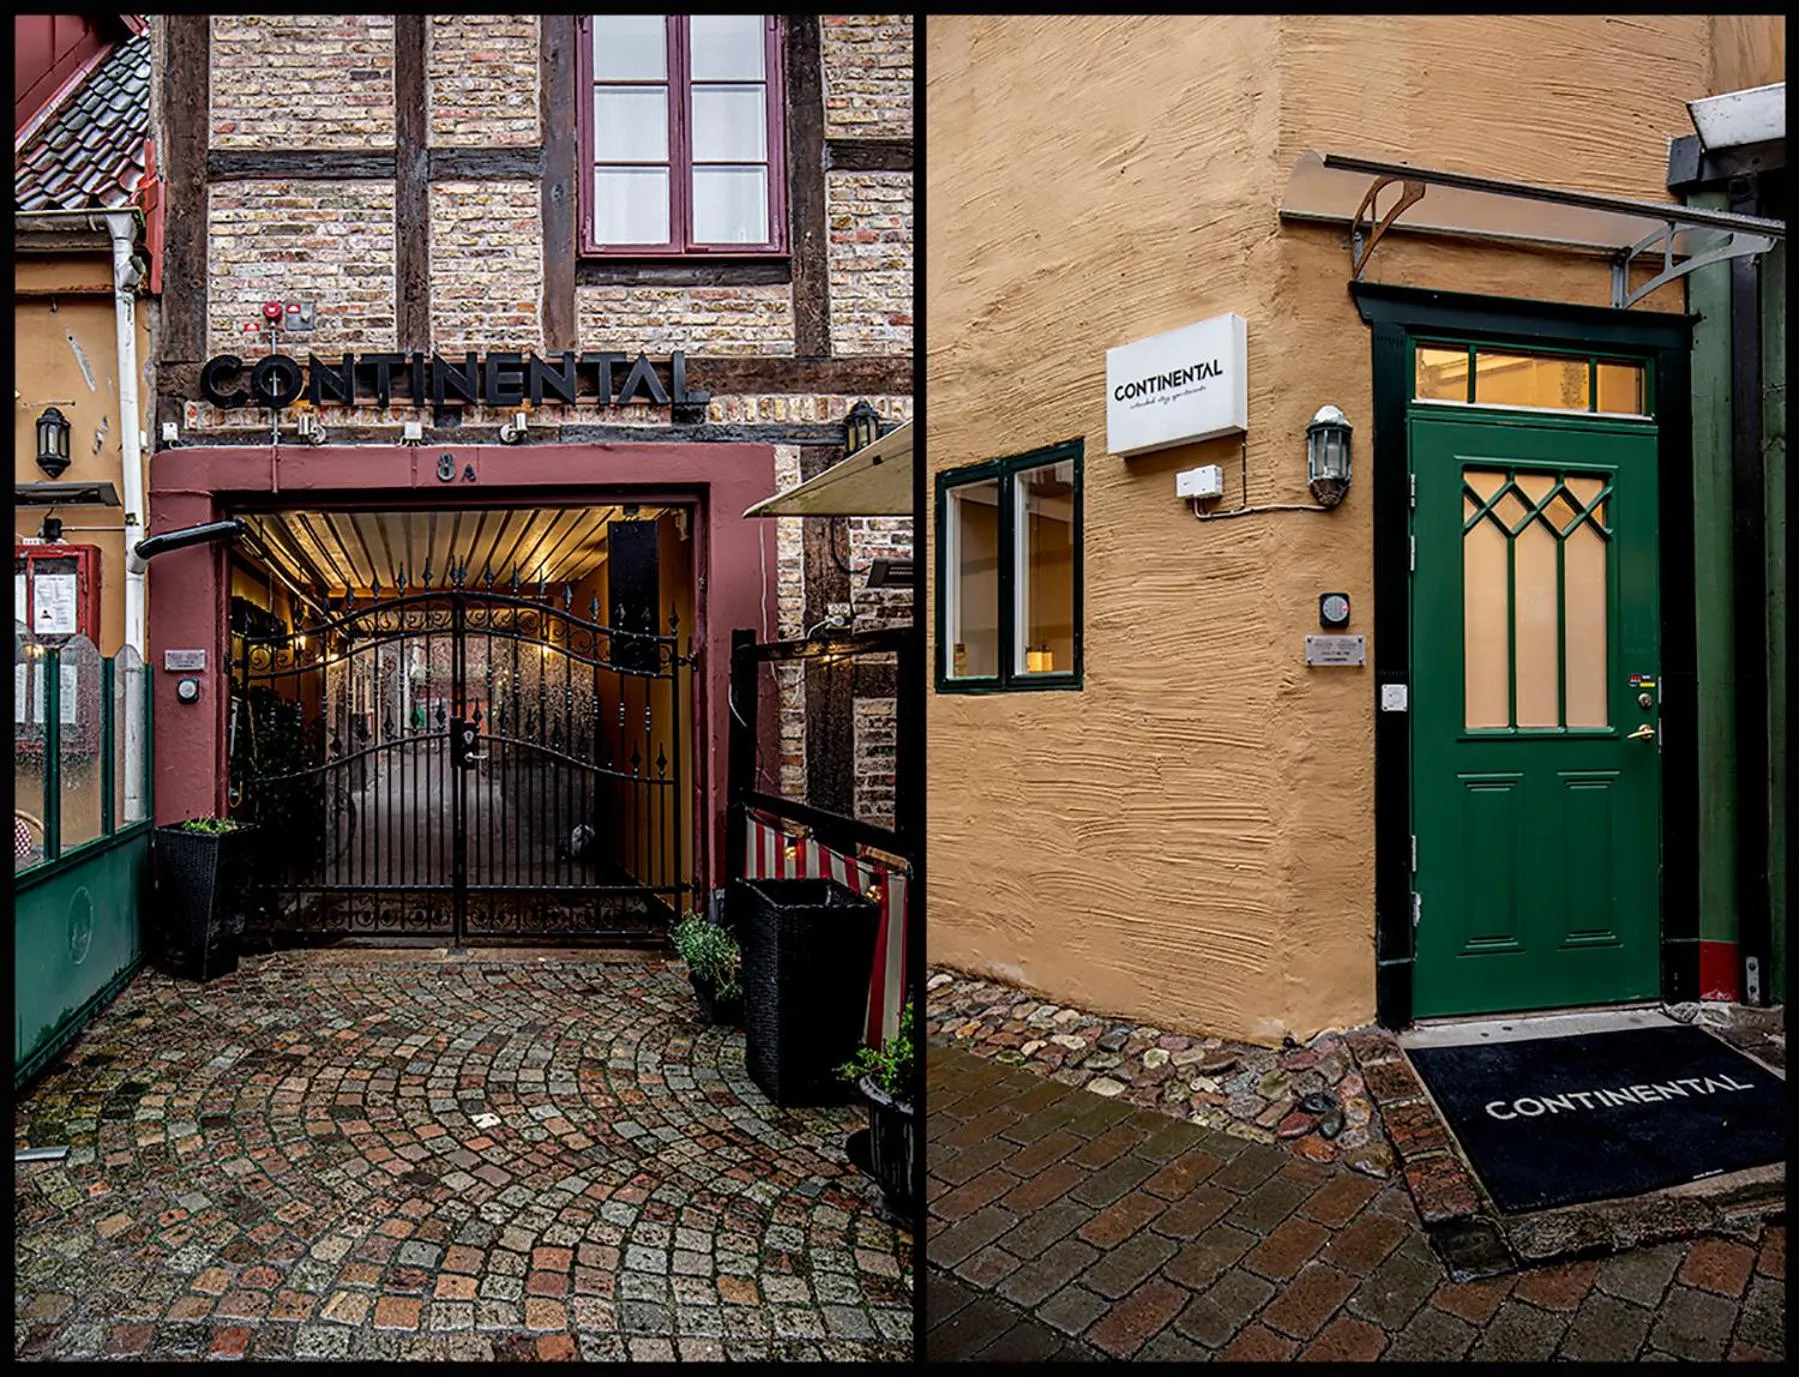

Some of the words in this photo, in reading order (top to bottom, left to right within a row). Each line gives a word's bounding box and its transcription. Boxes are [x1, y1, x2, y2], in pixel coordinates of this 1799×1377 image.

[200, 350, 710, 409] CONTINENTAL
[1113, 359, 1224, 402] CONTINENTAL
[1484, 1073, 1755, 1120] CONTINENTAL
